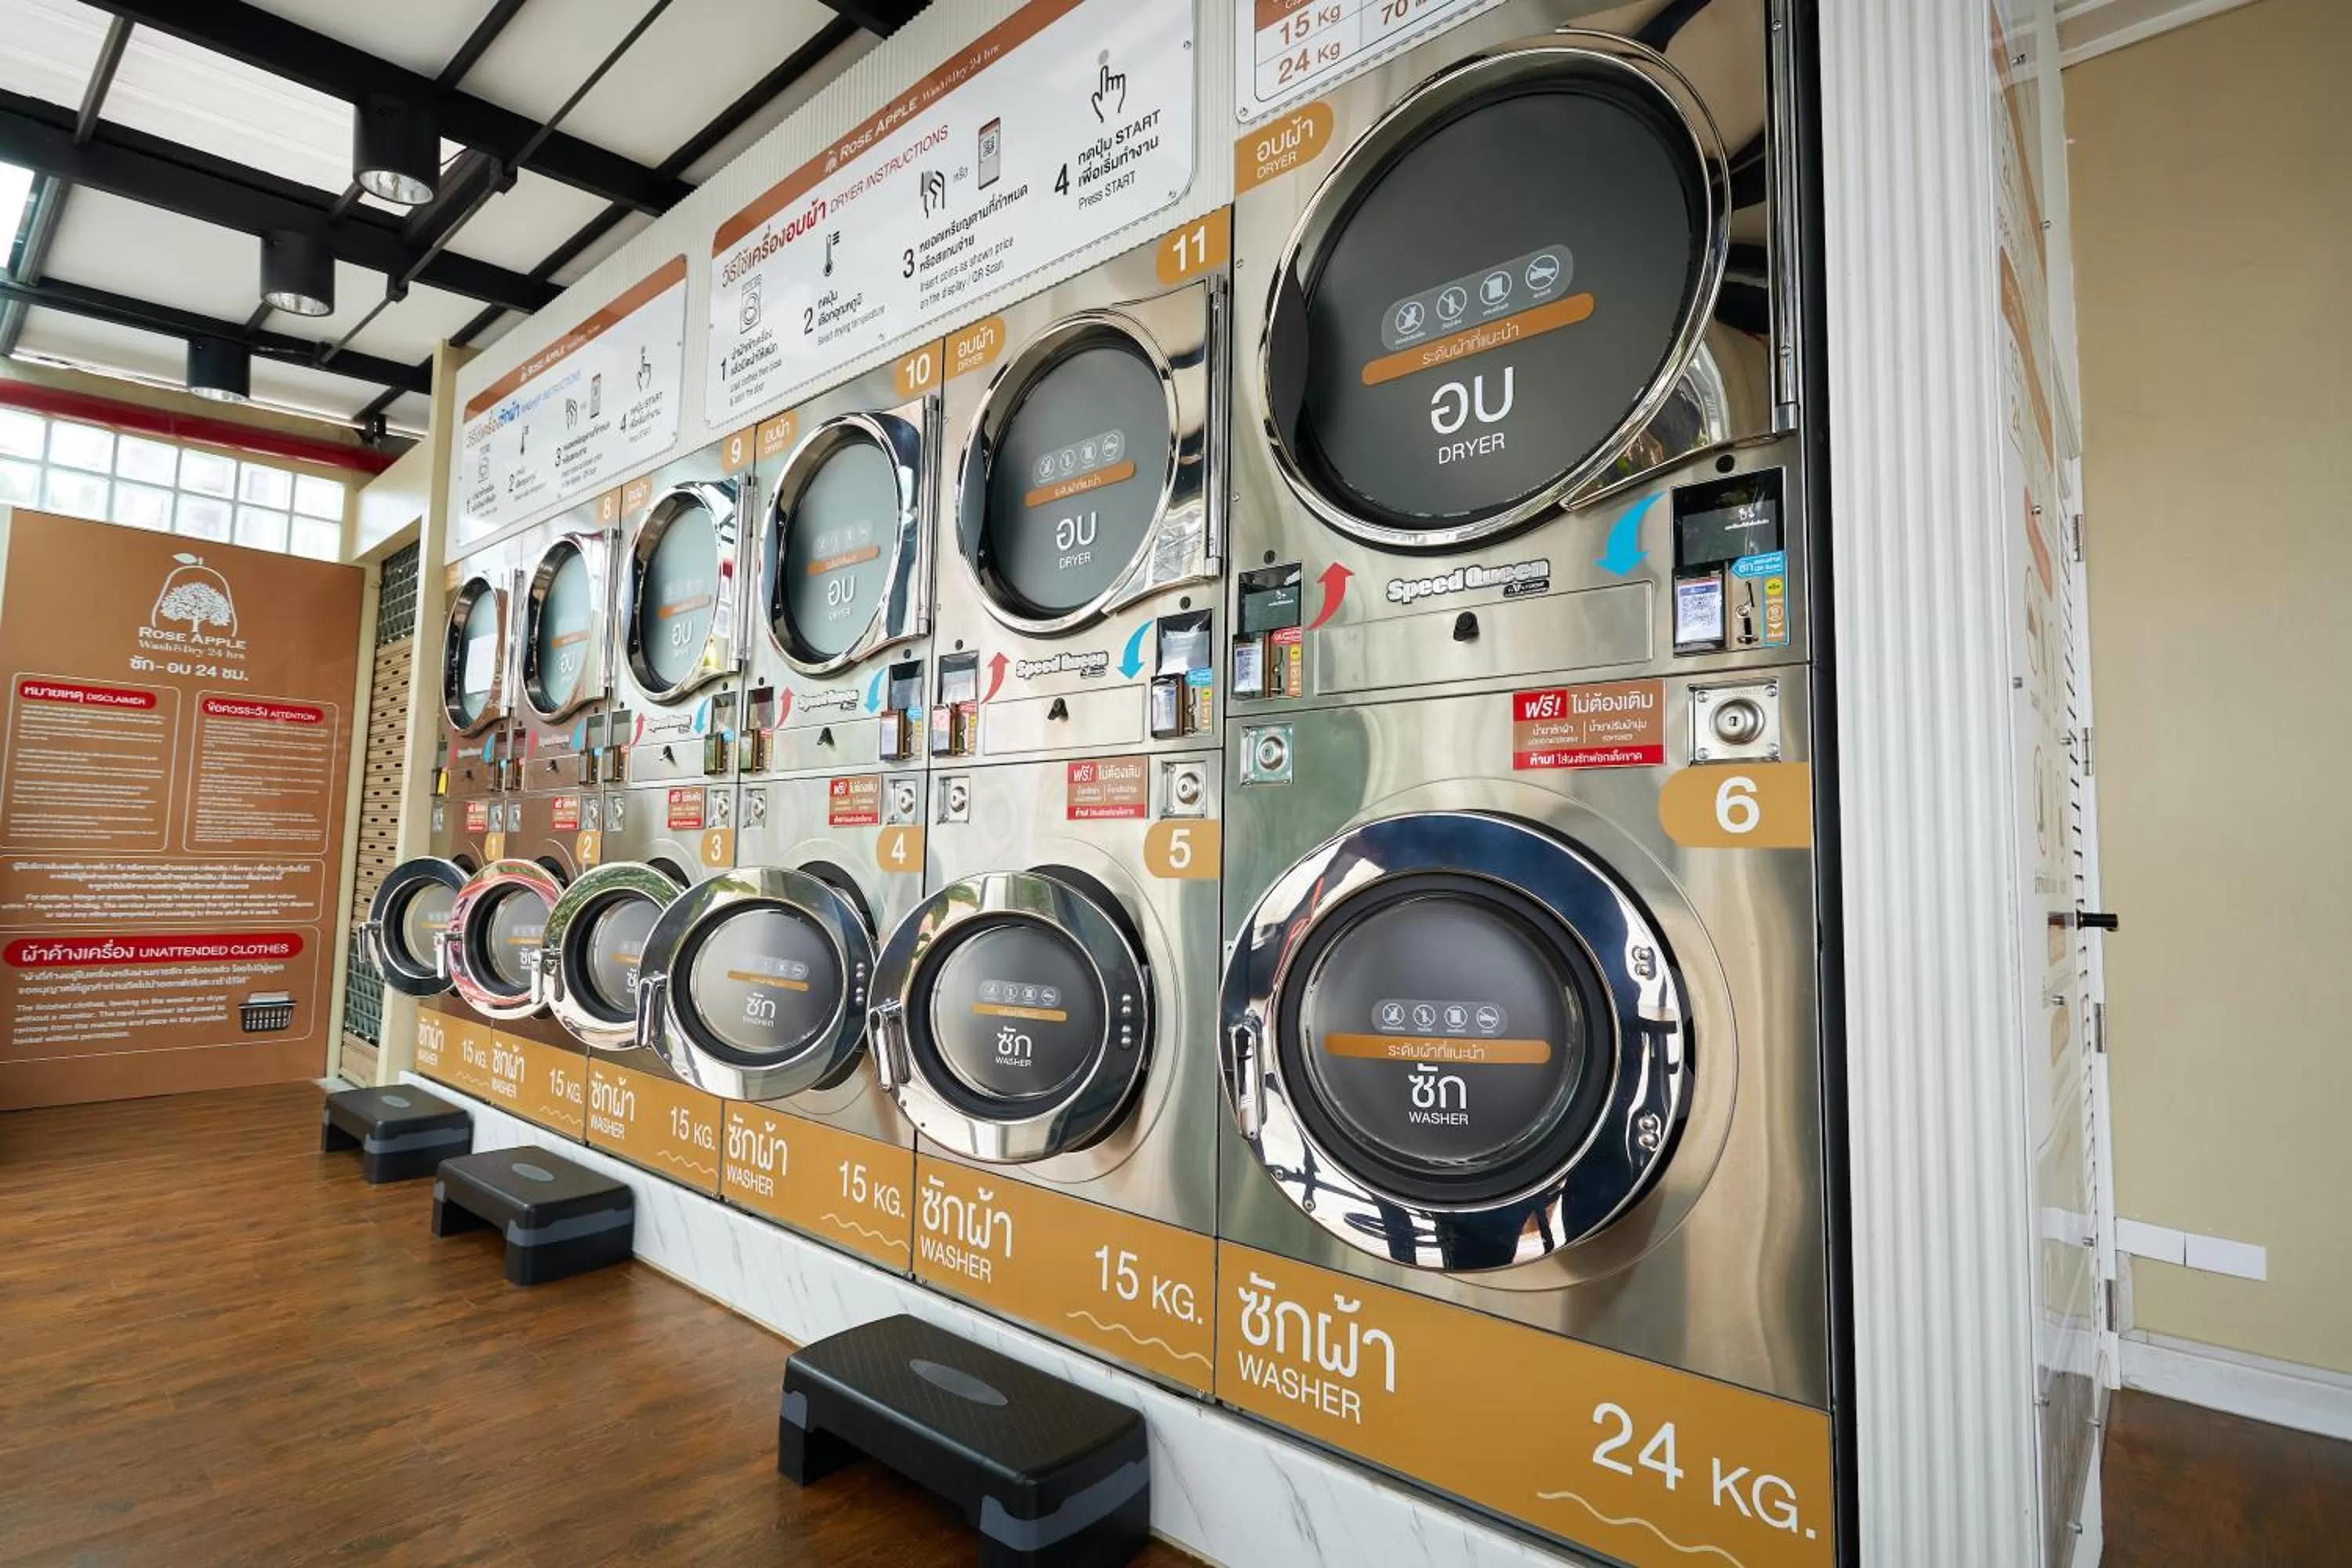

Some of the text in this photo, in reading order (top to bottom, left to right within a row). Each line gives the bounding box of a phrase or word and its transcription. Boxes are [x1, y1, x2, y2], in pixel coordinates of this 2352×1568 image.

[1279, 0, 1410, 45] 15 Kg 70
[1277, 42, 1341, 85] 24 Kg
[840, 129, 873, 161] ROSE
[874, 96, 918, 135] APPLE
[1256, 115, 1314, 162] อบผ้า
[829, 181, 864, 214] DRYER
[866, 124, 949, 187] INSTRUCTIONS
[1054, 108, 1162, 196] 4 กดปุ่ม START
[1257, 150, 1297, 180] DRYER
[1078, 170, 1136, 210] Press START
[903, 248, 915, 278] 3
[1173, 225, 1206, 273] 11
[804, 307, 813, 336] 2
[957, 325, 994, 358] อบผ้า
[720, 357, 728, 382] 1
[906, 354, 931, 390] 10
[1430, 366, 1515, 435] อบ
[620, 413, 627, 431] 4
[555, 447, 562, 468] 3
[731, 437, 742, 465] 9
[1439, 431, 1505, 465] DRYER
[508, 474, 515, 493] 2
[603, 495, 612, 521] 8
[1056, 511, 1097, 551] อบ
[1059, 551, 1092, 570] DRYER
[828, 573, 856, 607] อบ
[1385, 567, 1465, 604] Speed
[1465, 557, 1551, 590] Queen
[138, 626, 247, 650] ROSE APPLE
[671, 619, 694, 646] อบ
[195, 664, 217, 677] 24
[86, 692, 146, 706] DISCLAIMER
[270, 710, 316, 721] ATTENTION
[1524, 690, 1654, 719] ฟรี! ไม่ต้องเติม
[1715, 775, 1760, 834] 6
[583, 837, 592, 859] 2
[710, 833, 723, 862] 3
[891, 832, 906, 865] 4
[1167, 828, 1192, 870] 5
[22, 938, 289, 962] ผ้าค้างเครื่อง UNATTENDED CLOTHES
[746, 992, 777, 1019] ซัก
[461, 1038, 474, 1065] 15
[996, 1025, 1033, 1058] ซัก
[1388, 1040, 1485, 1061] ระดับผ้าที่แนะนำ
[492, 1040, 525, 1084] ซักผ้า
[995, 1055, 1033, 1068] WASHER
[549, 1068, 583, 1105] 15 KG.
[590, 1071, 637, 1123] ซักผ้า
[1408, 1062, 1468, 1110] ซัก
[590, 1112, 626, 1141] WASHER
[670, 1105, 717, 1152] 15 KG.
[1408, 1110, 1469, 1127] WASHER
[728, 1112, 789, 1177] ซักผ้า
[726, 1163, 775, 1199] WASHER
[839, 1160, 906, 1218] 15 KG.
[920, 1173, 1014, 1258] ซักผ้า
[920, 1234, 993, 1284] WASHER
[1094, 1243, 1204, 1325] 15 KG.
[1238, 1270, 1396, 1395] ซักผ้า
[1238, 1349, 1363, 1425] WASHER
[1592, 1401, 1817, 1541] 24 KG.
